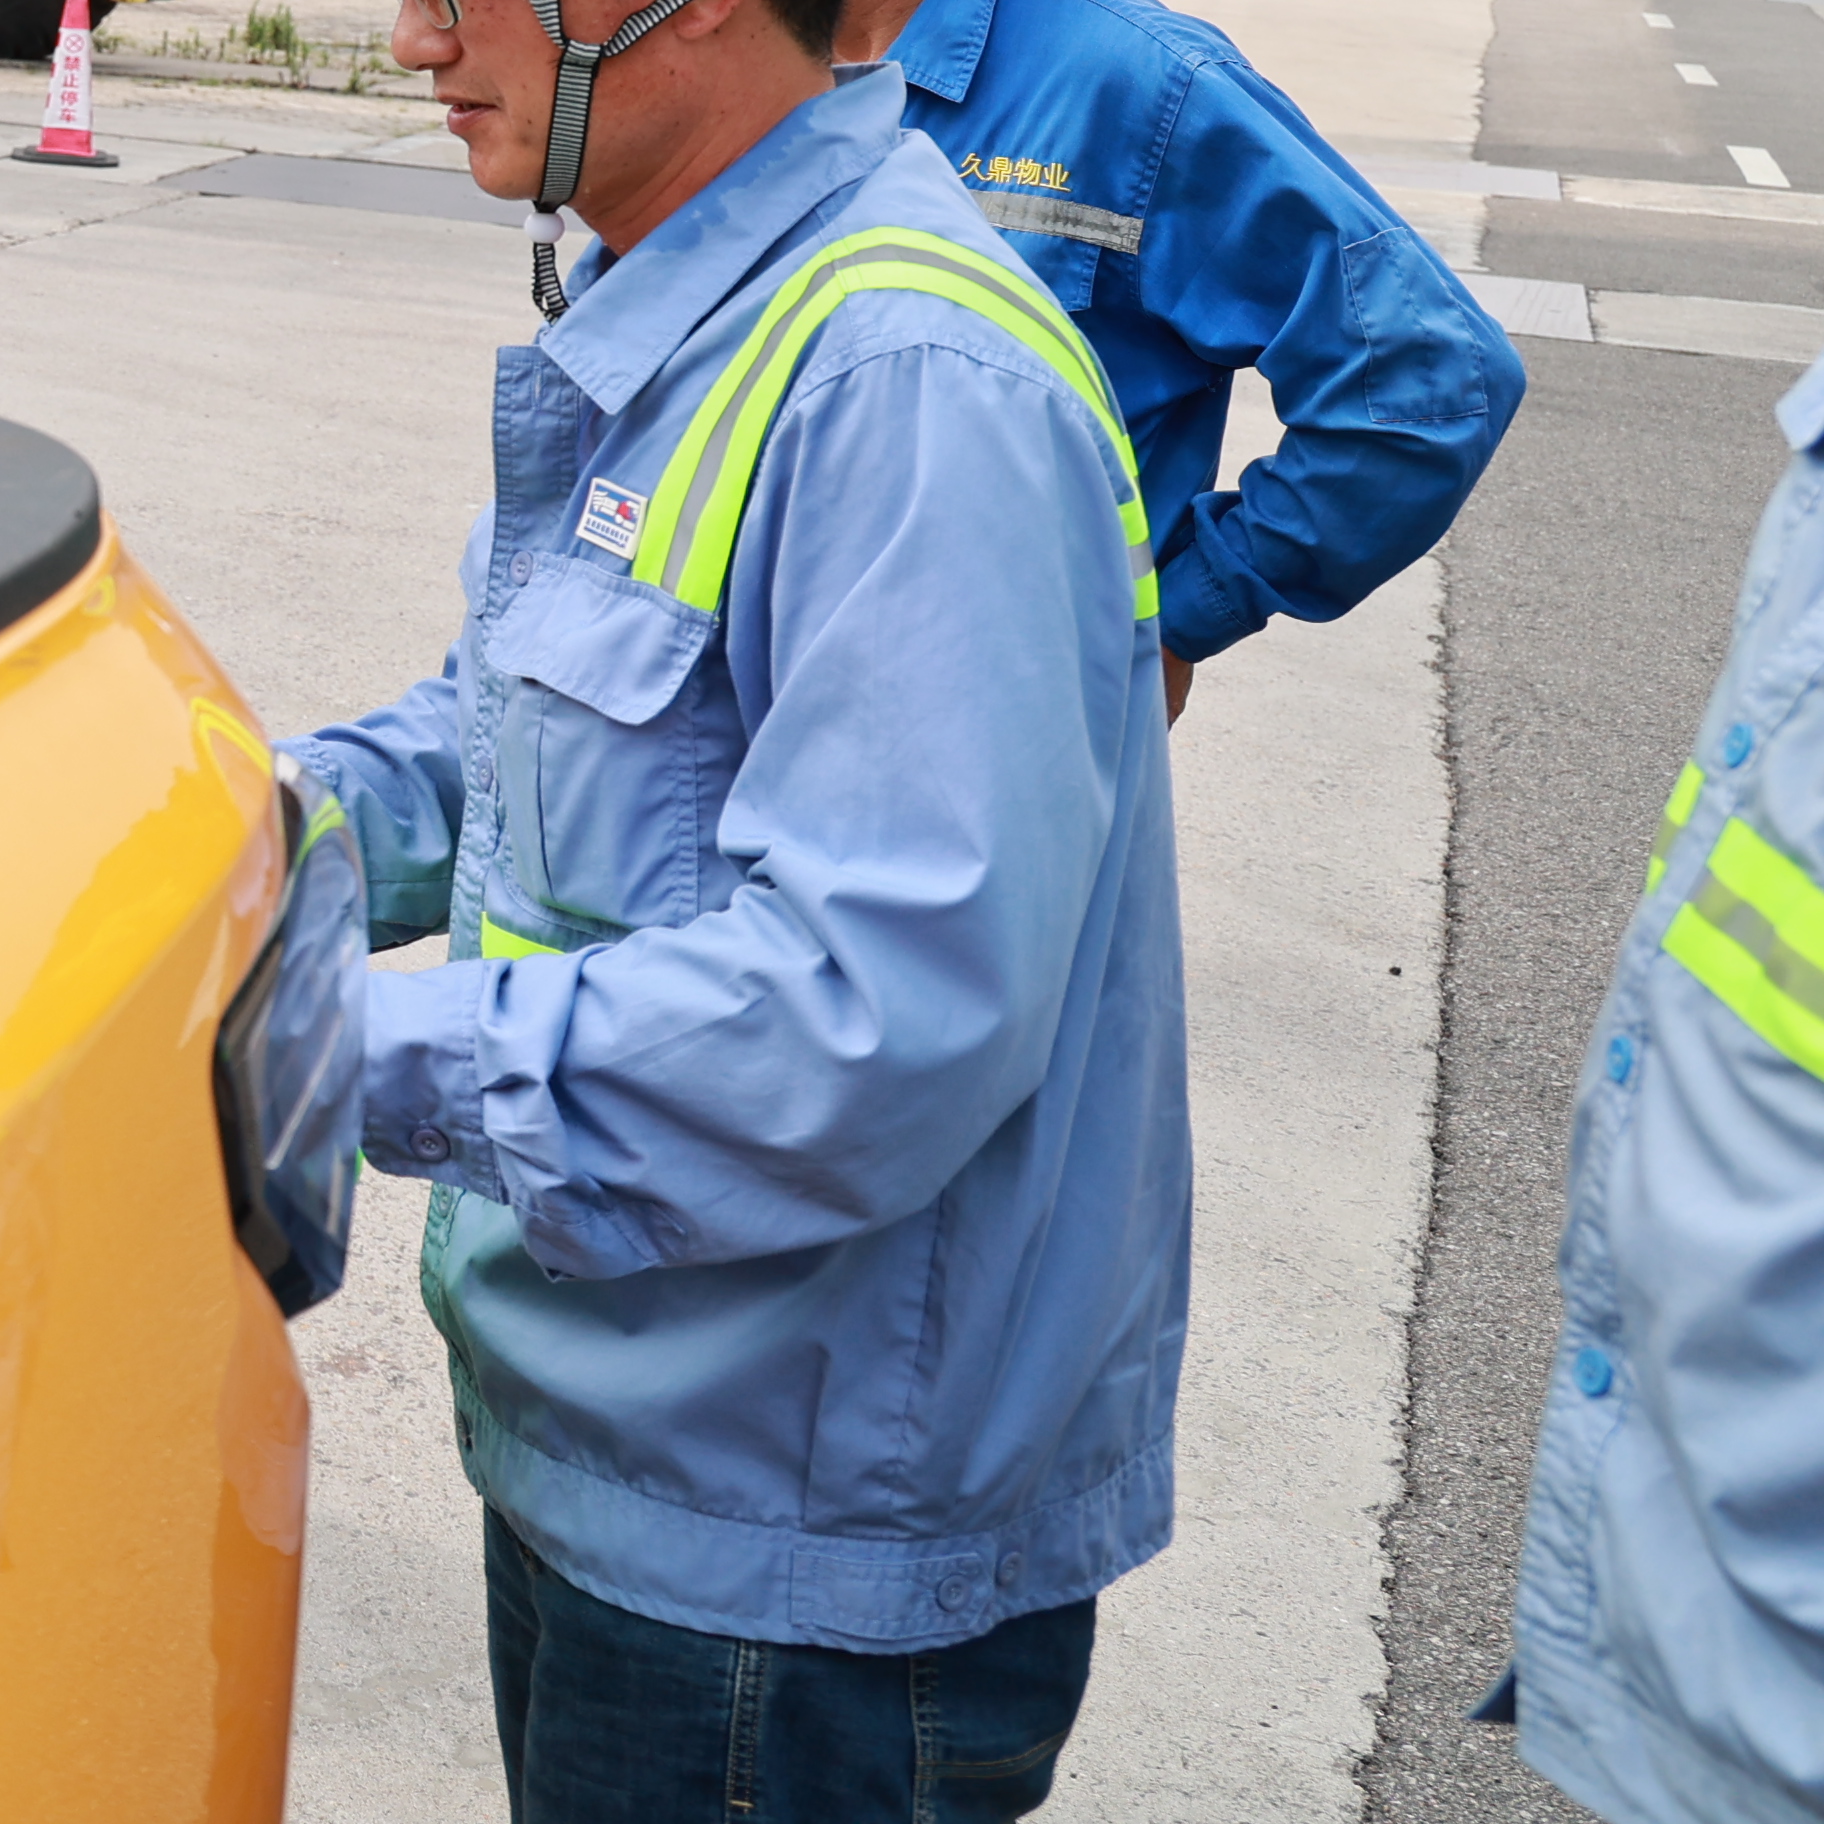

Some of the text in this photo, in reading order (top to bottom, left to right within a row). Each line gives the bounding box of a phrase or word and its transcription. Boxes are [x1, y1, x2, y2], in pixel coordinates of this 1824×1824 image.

[60, 56, 81, 123] 禁止停车
[959, 152, 1072, 192] 久鼎物业
